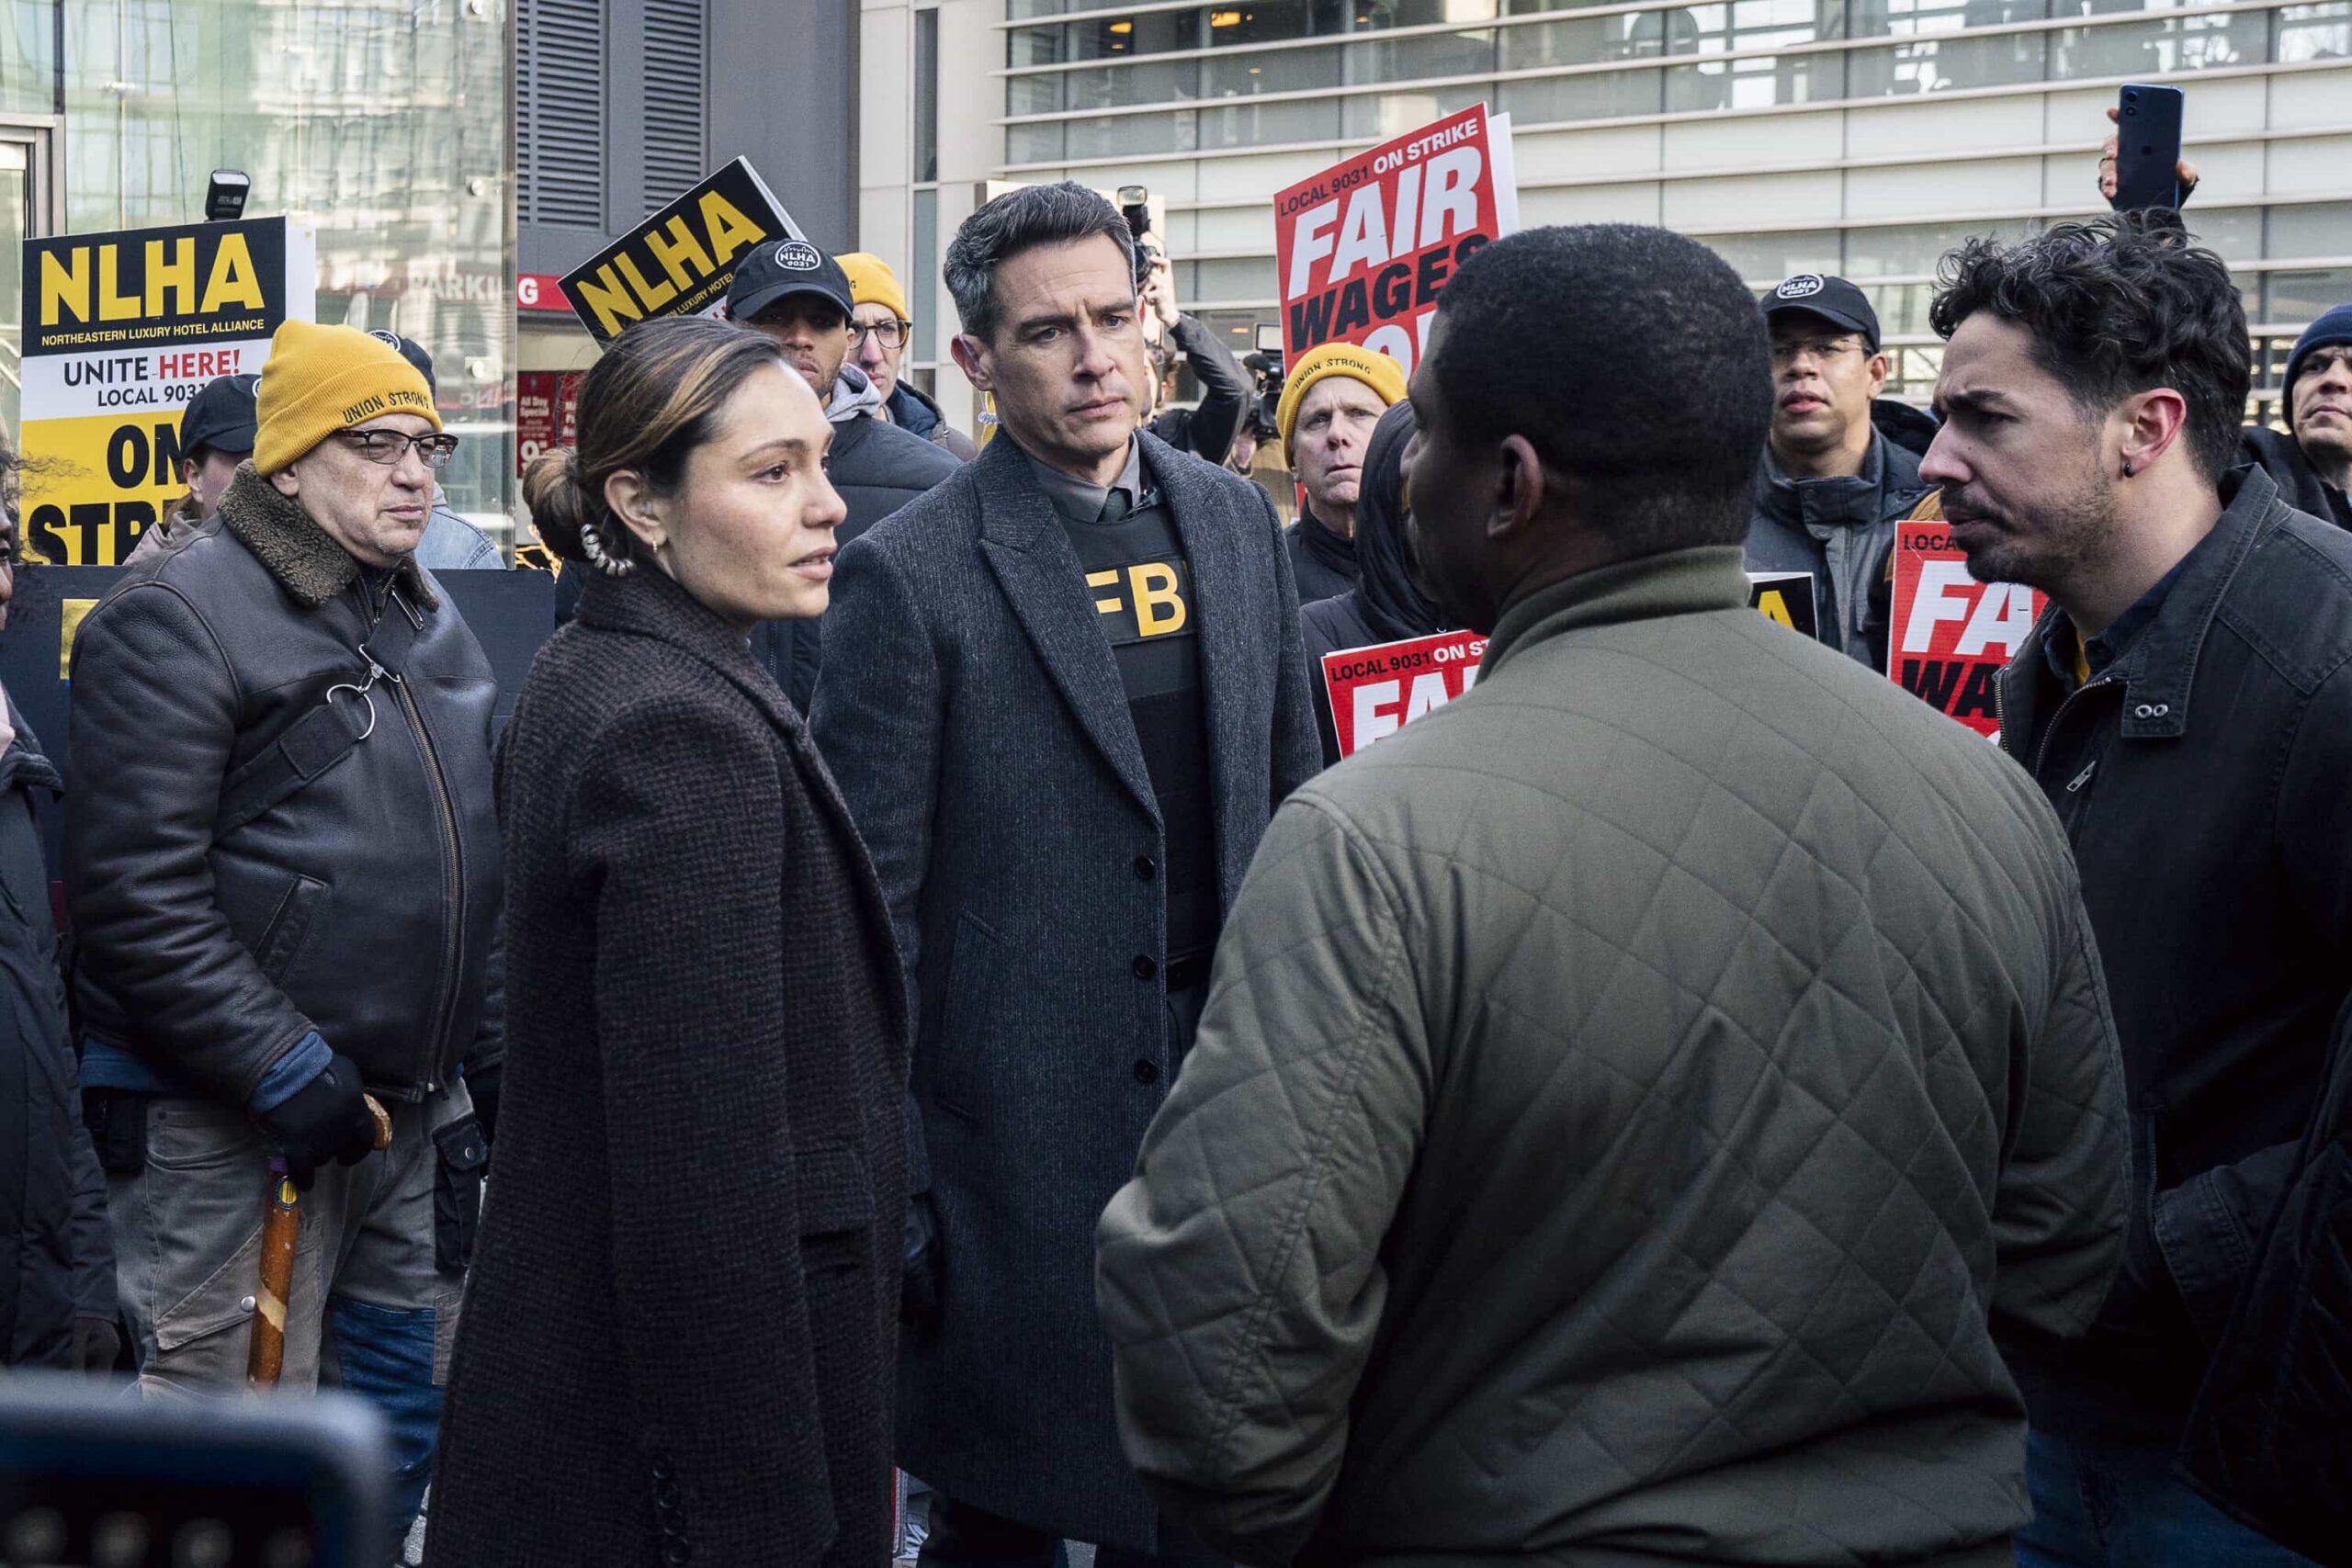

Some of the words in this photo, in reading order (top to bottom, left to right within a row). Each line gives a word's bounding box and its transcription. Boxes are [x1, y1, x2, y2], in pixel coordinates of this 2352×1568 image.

[1280, 186, 1329, 217] LOCAL
[1331, 164, 1369, 193] 9031
[1373, 149, 1404, 175] ON
[1407, 118, 1479, 162] STRIKE
[1287, 145, 1482, 301] FAIR
[576, 189, 767, 338] NLHA
[779, 252, 816, 265] NLHA
[40, 232, 266, 326] NLHA
[679, 288, 709, 314] LUXURY
[41, 329, 127, 346] NORTHEASTERN
[129, 326, 171, 339] LUXURY
[173, 322, 209, 335] HOTEL
[210, 319, 265, 333] ALLIANCE
[63, 356, 149, 387] UNITE
[159, 349, 241, 379] HERE!
[1294, 361, 1322, 389] UNION
[1326, 358, 1371, 375] STRONG
[97, 386, 159, 407] LOCAL
[342, 395, 385, 423] UNION
[388, 391, 429, 410] STRONG
[28, 499, 179, 567] STR
[1904, 534, 1956, 551] LOCA
[1085, 561, 1189, 637] FB
[1901, 559, 2033, 658] FA
[1331, 661, 1388, 682] LOCAL
[1389, 651, 1430, 671] 9031
[1433, 644, 1465, 663] ON
